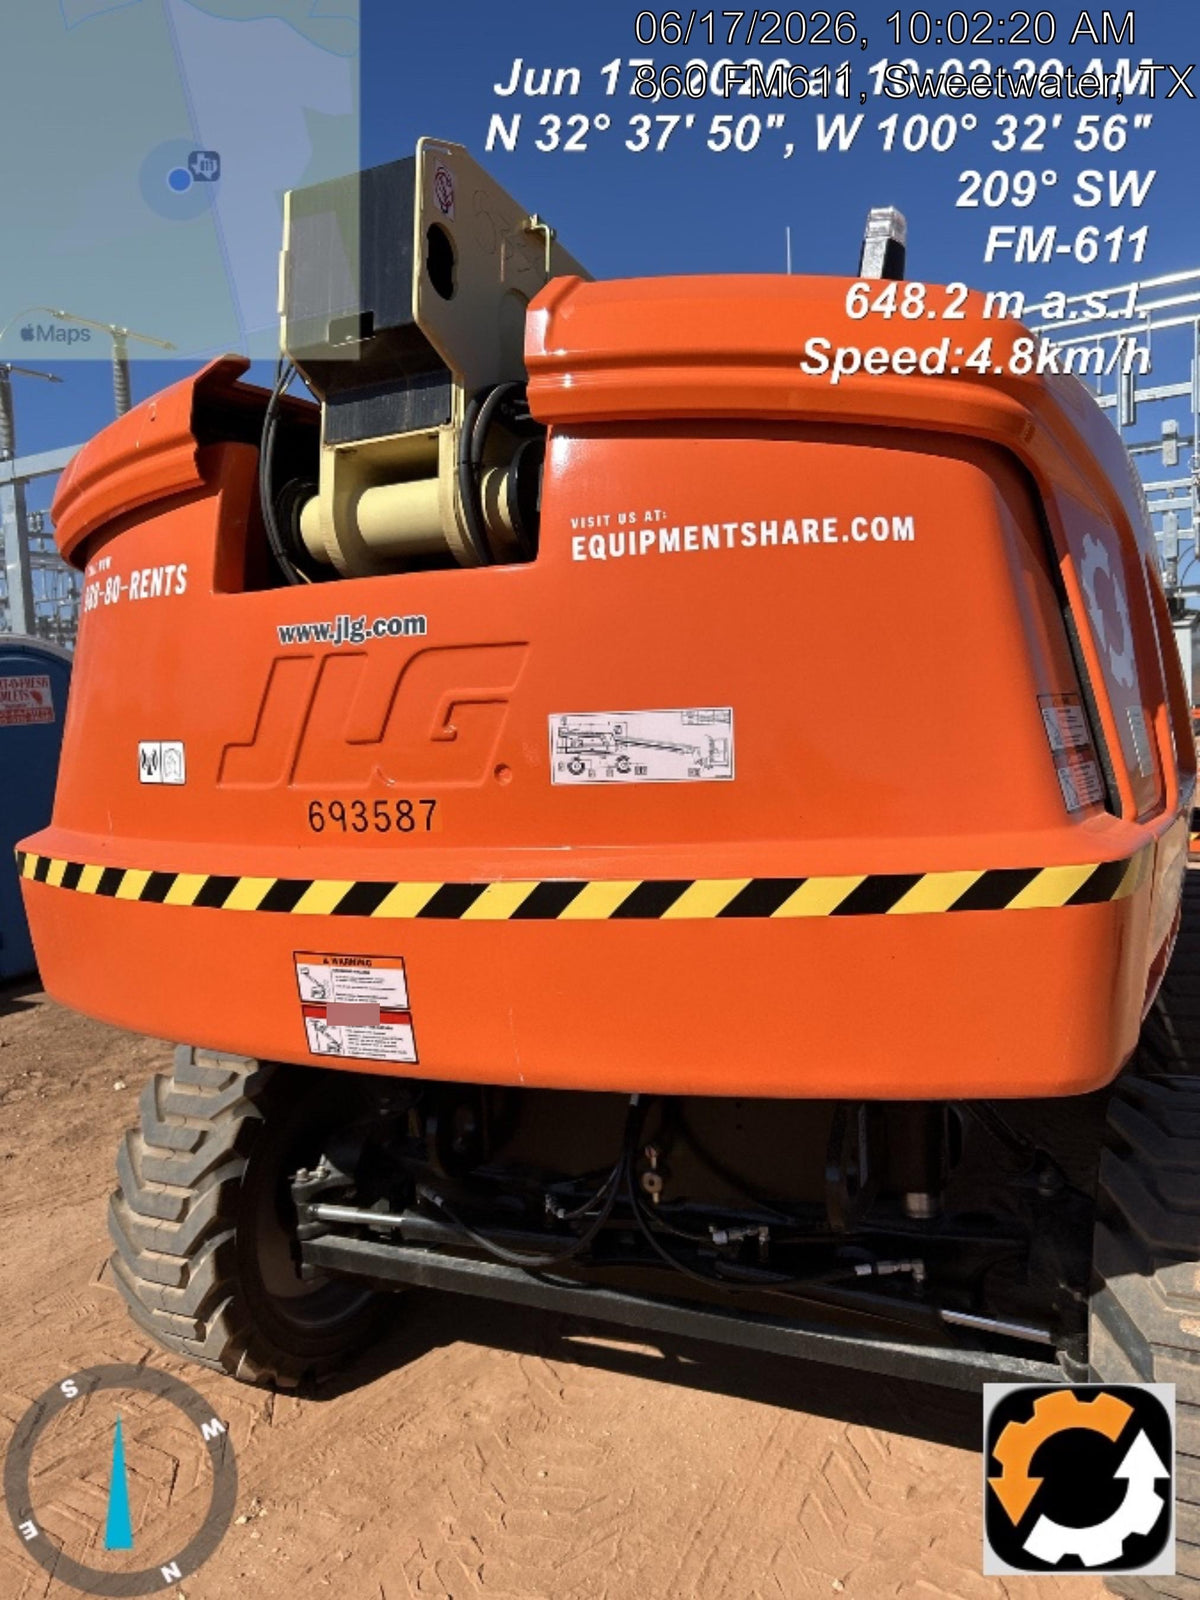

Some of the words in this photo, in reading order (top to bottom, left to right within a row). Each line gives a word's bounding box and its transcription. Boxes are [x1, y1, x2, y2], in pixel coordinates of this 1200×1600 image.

[571, 515, 610, 529] VISIT
[618, 512, 637, 525] US
[644, 509, 668, 522] AT:
[572, 516, 915, 561] EQUIPMENTSHARE.COM
[278, 615, 427, 646] www.jlg.com
[216, 641, 530, 789] JLG
[308, 800, 437, 832] 693587
